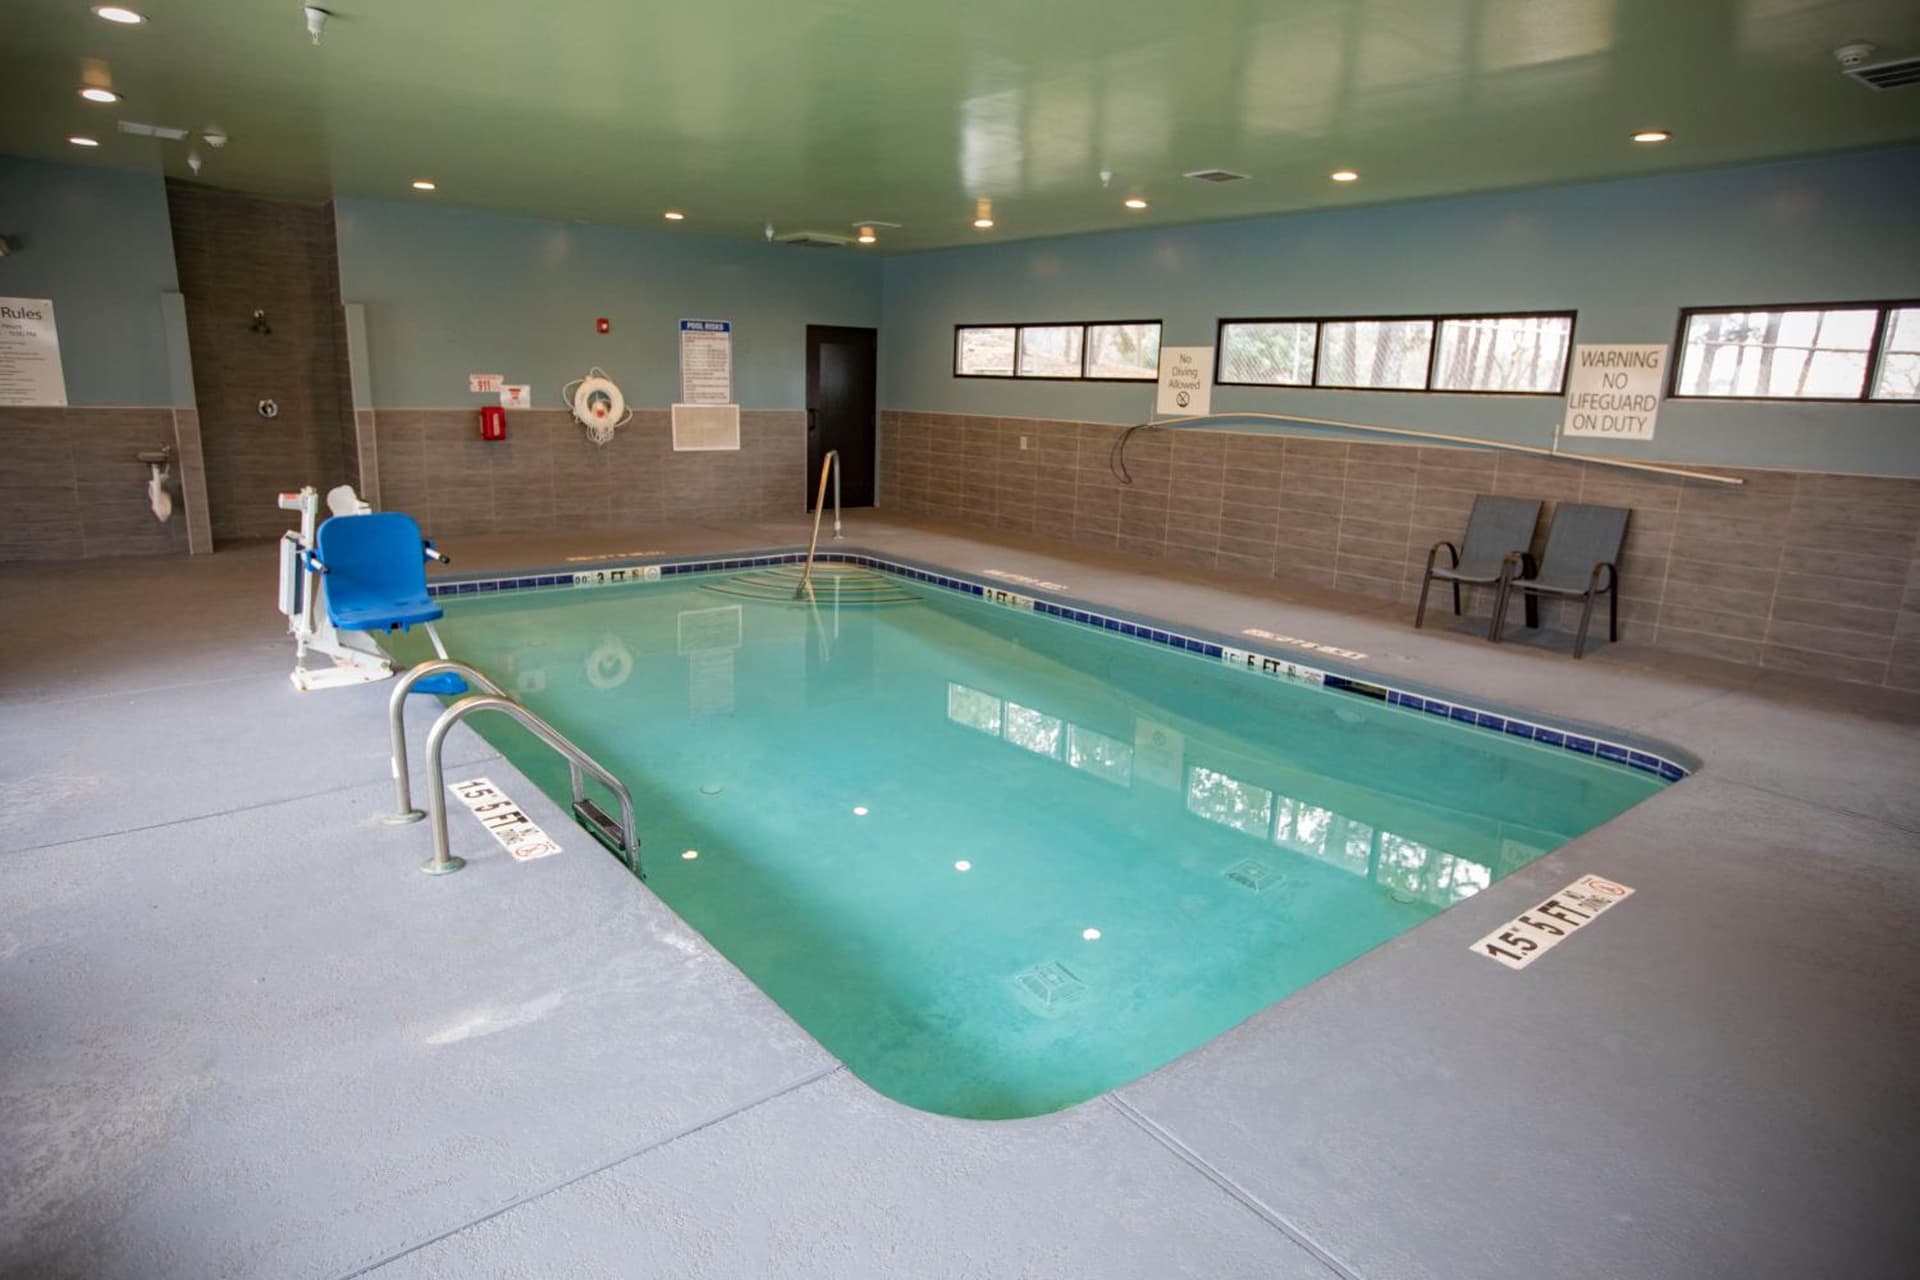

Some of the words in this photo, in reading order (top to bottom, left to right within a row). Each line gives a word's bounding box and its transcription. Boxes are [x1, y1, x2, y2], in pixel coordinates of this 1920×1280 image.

[1, 306, 43, 320] Rules
[1179, 352, 1192, 364] No
[1581, 350, 1660, 368] WARNING
[1171, 366, 1198, 379] Diving
[1602, 372, 1629, 390] NO
[1167, 379, 1201, 390] Allowed
[1569, 392, 1657, 412] LIFEGUARD
[1572, 413, 1597, 430] ON
[1601, 415, 1648, 433] DUTY
[1262, 658, 1281, 673] FT
[482, 811, 529, 830] FT
[1537, 900, 1591, 926] FT
[1517, 915, 1566, 937] 5
